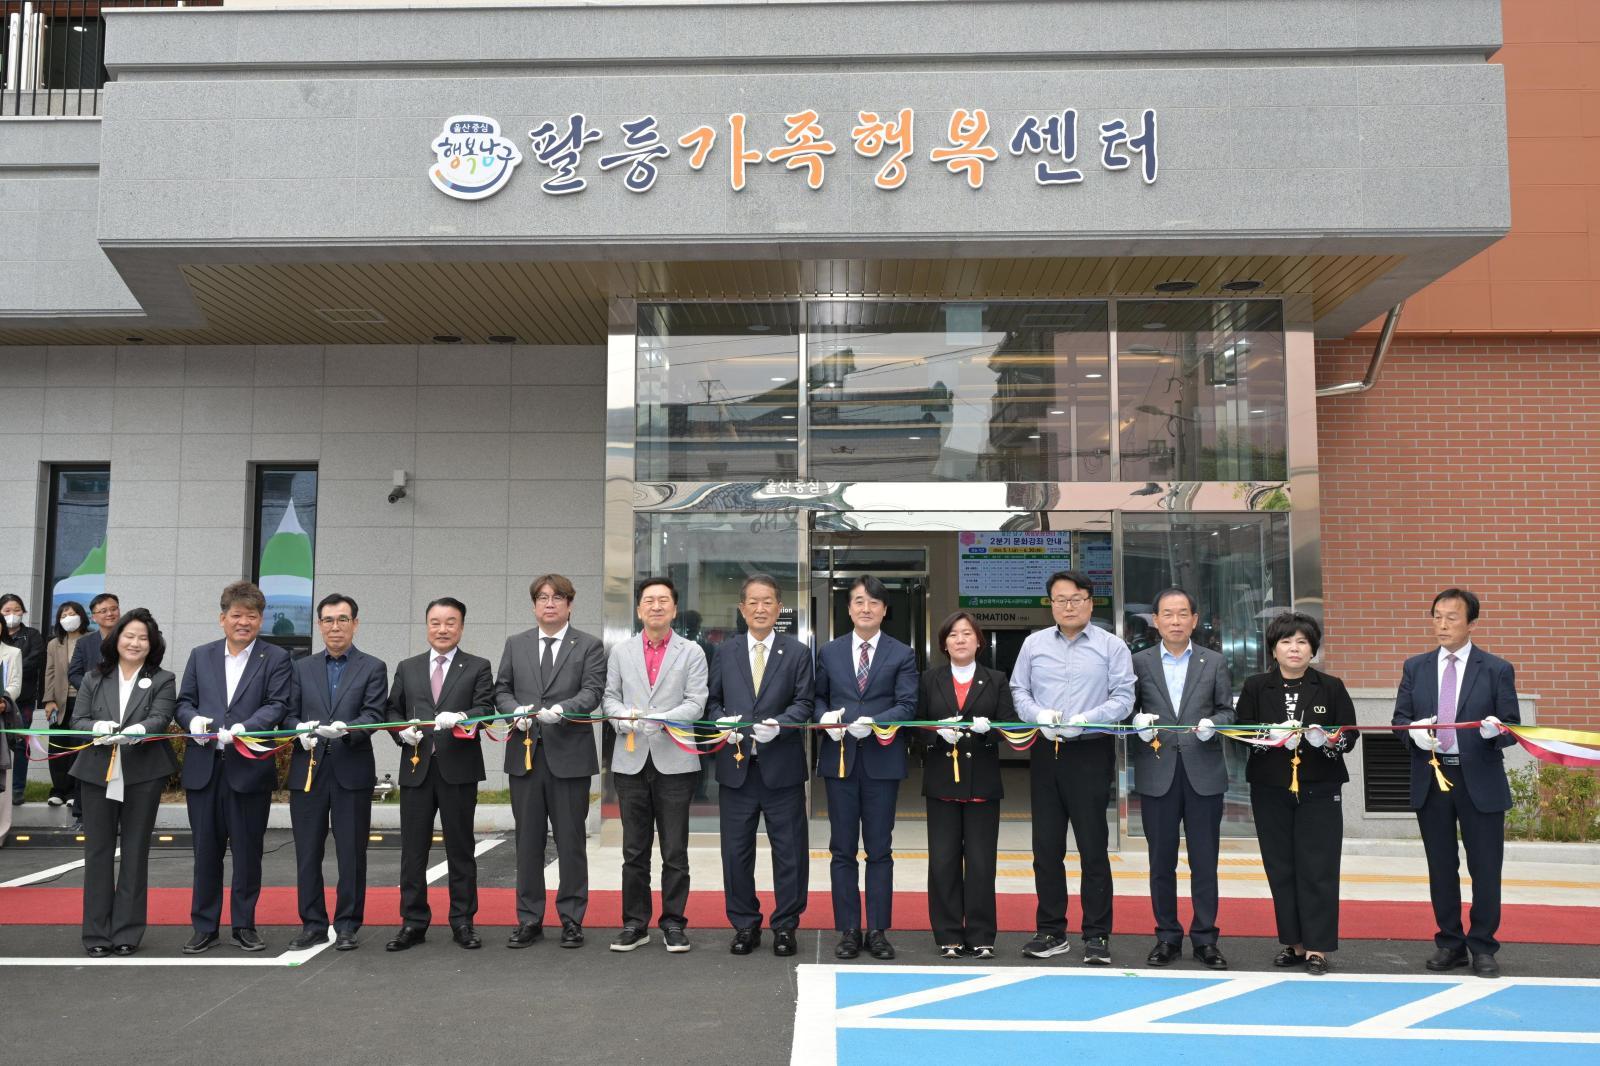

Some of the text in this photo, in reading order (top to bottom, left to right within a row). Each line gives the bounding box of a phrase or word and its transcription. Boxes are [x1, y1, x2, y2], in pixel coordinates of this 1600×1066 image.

[990, 537, 1011, 546] 2분기
[1013, 537, 1044, 546] 문화강좌
[1046, 537, 1062, 546] 안내
